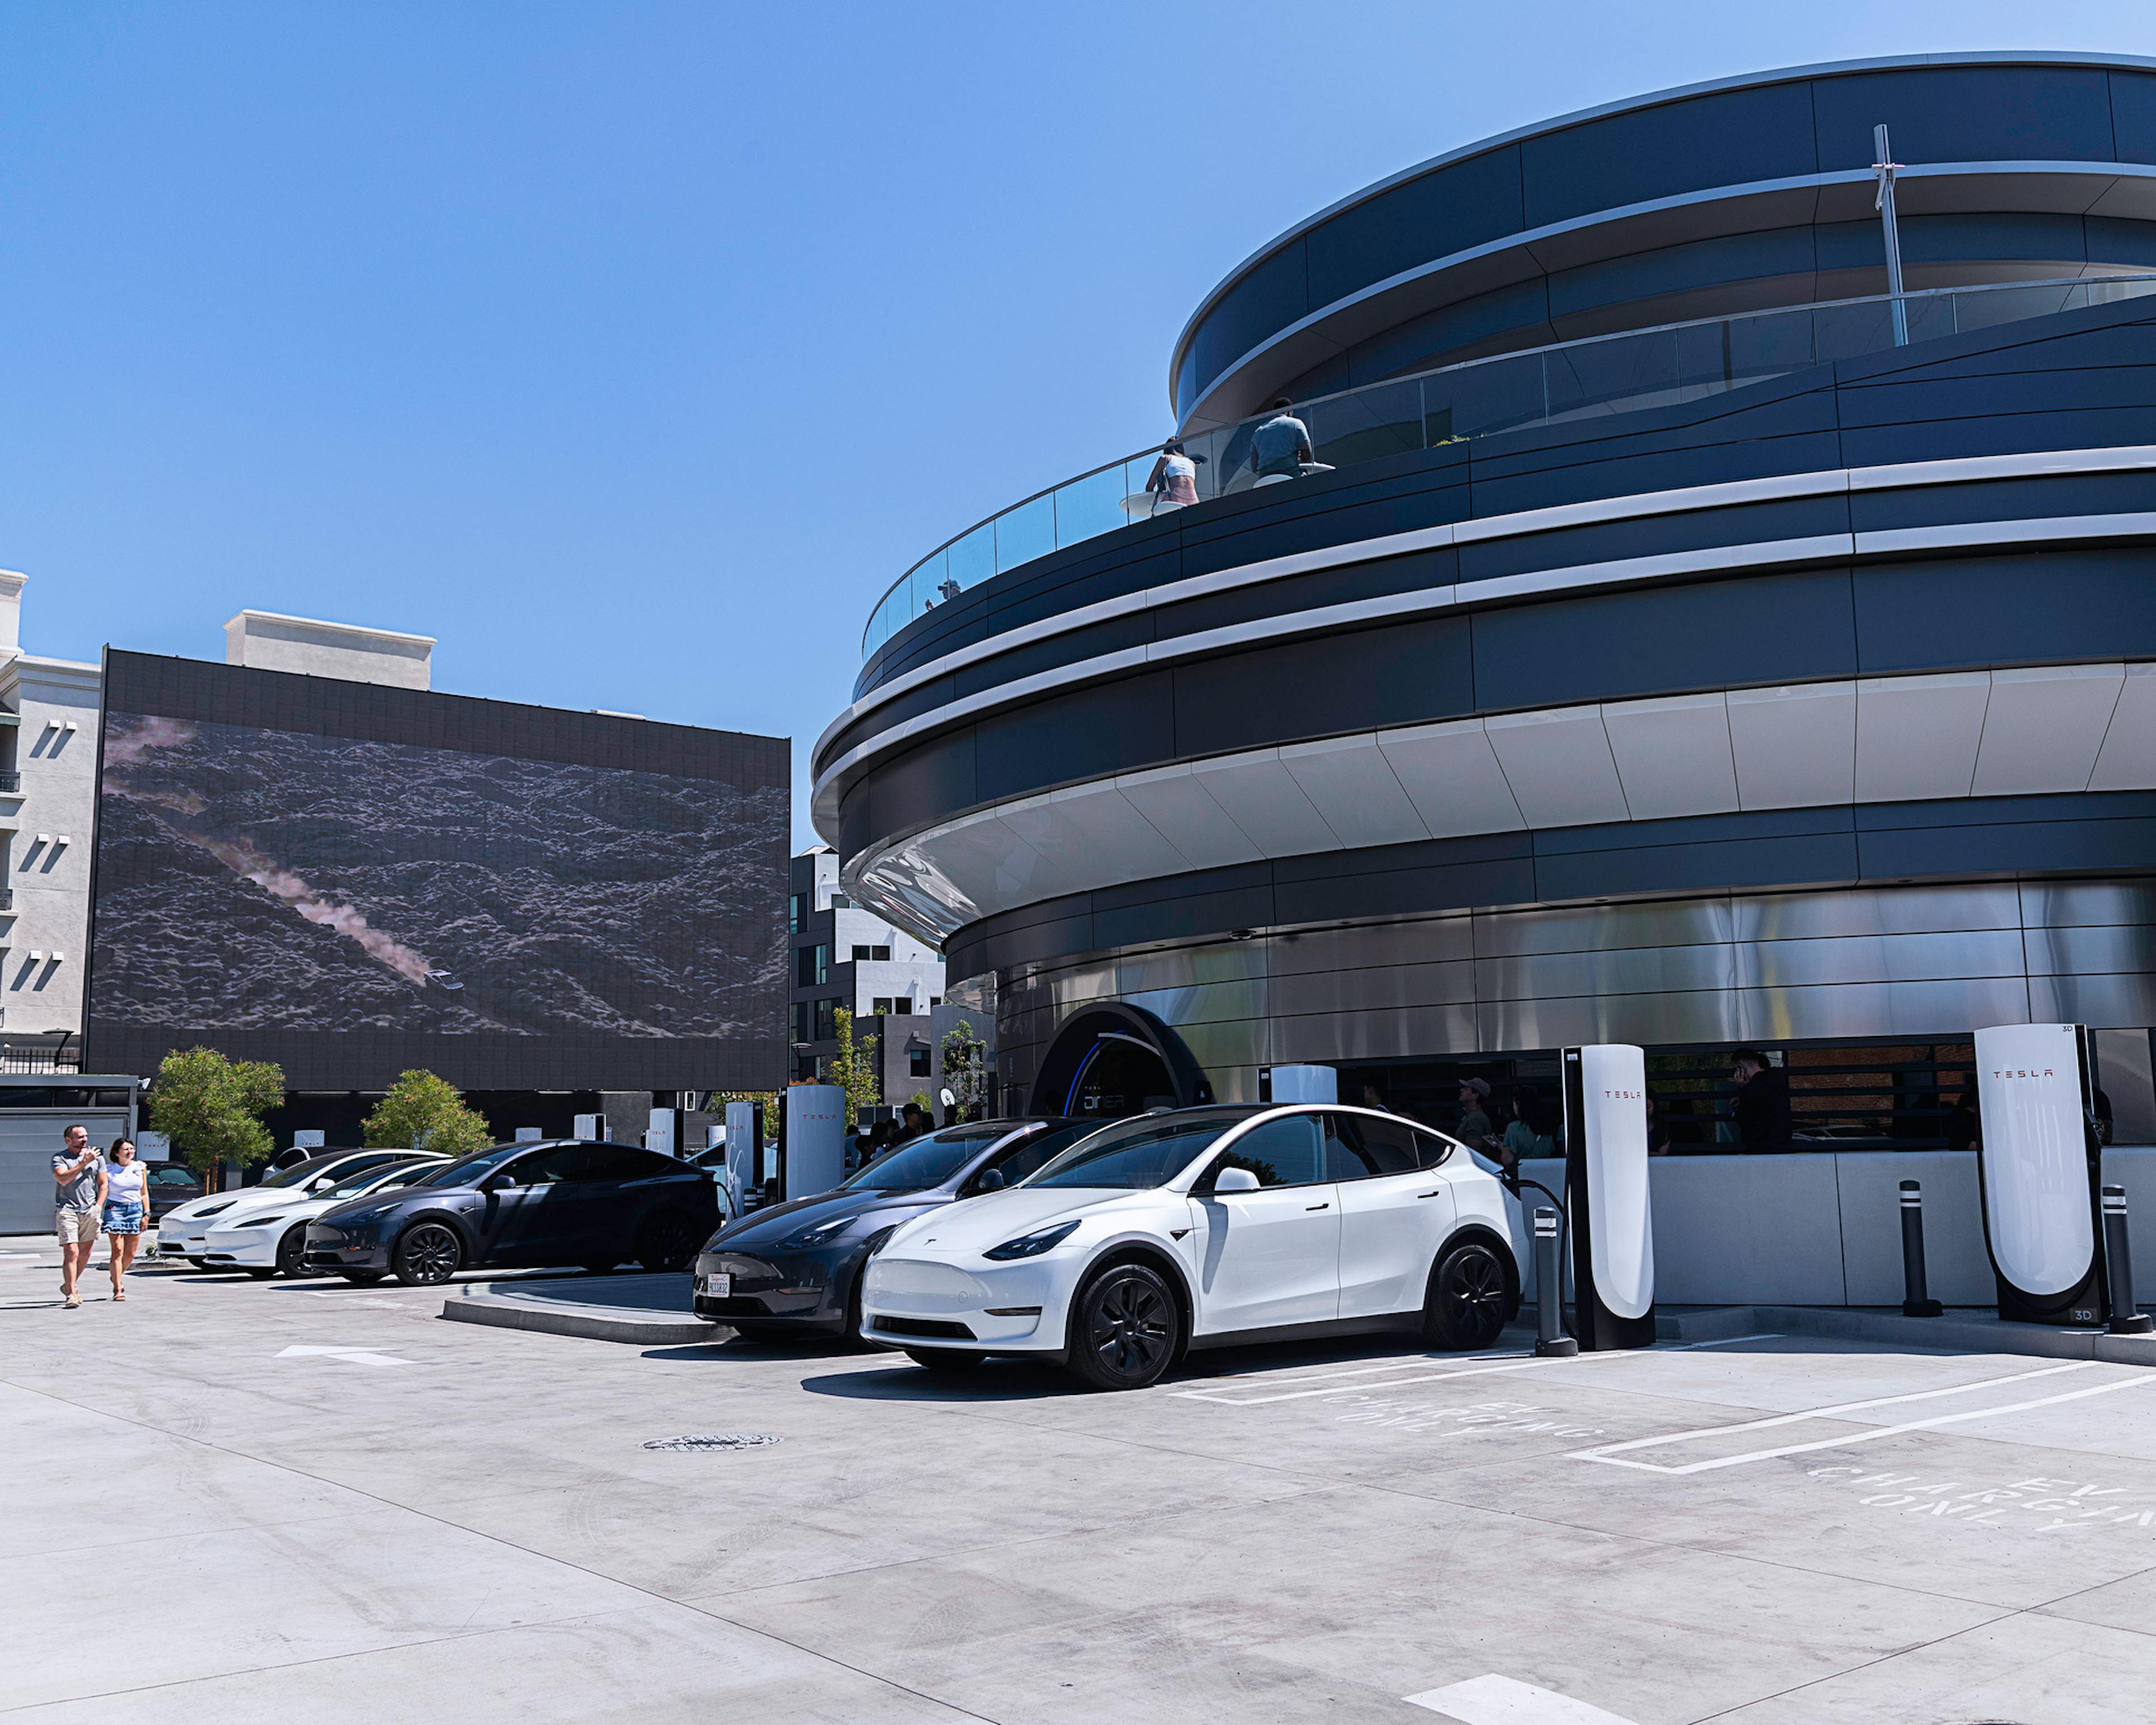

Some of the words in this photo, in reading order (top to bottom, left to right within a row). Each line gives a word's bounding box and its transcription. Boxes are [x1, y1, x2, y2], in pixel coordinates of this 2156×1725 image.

[1993, 1069, 2053, 1078] TESLA
[2075, 1310, 2093, 1320] 3D
[1322, 1395, 1605, 1438] CHARGING
[1469, 1402, 1560, 1414] EV
[1335, 1412, 1491, 1438] ONLY
[2006, 1477, 2128, 1497] EV
[1859, 1494, 2093, 1532] ONLY
